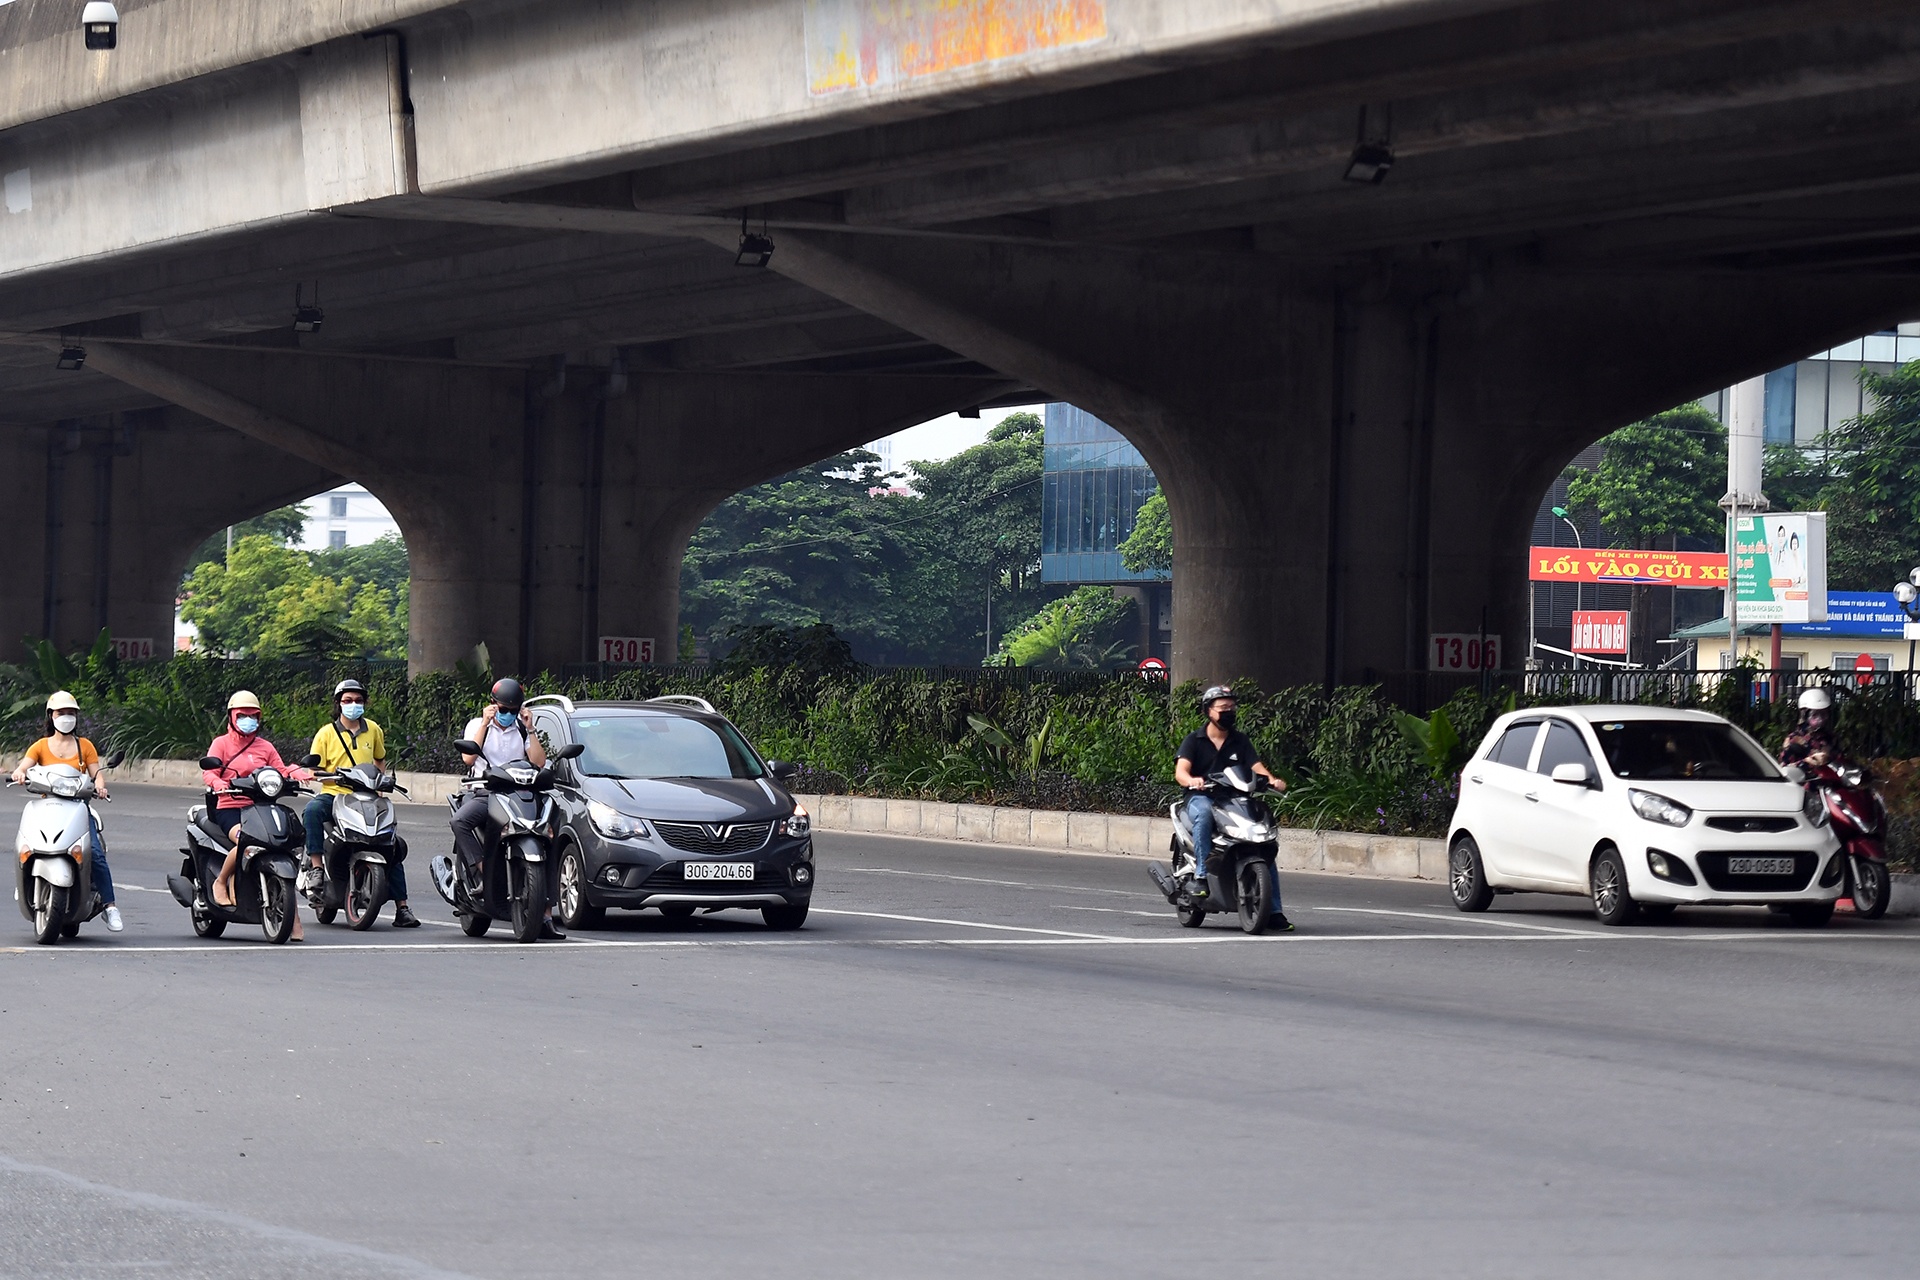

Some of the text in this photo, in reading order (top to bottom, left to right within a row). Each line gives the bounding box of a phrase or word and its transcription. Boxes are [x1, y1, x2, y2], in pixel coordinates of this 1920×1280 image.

[1594, 550, 1615, 558] BẾN
[1652, 552, 1677, 560] ĐÌNH
[1539, 555, 1728, 580] LỐI VÀO GỬI XE
[1875, 613, 1894, 622] THÁNG
[1895, 614, 1903, 622] XE
[1574, 614, 1582, 649] LỐI
[1593, 624, 1601, 649] XE
[1613, 616, 1625, 650] BẾN
[604, 639, 651, 663] T305
[1436, 638, 1496, 670] T306
[686, 864, 753, 879] 30G-204.66
[1731, 859, 1793, 873] 29D-095.99
